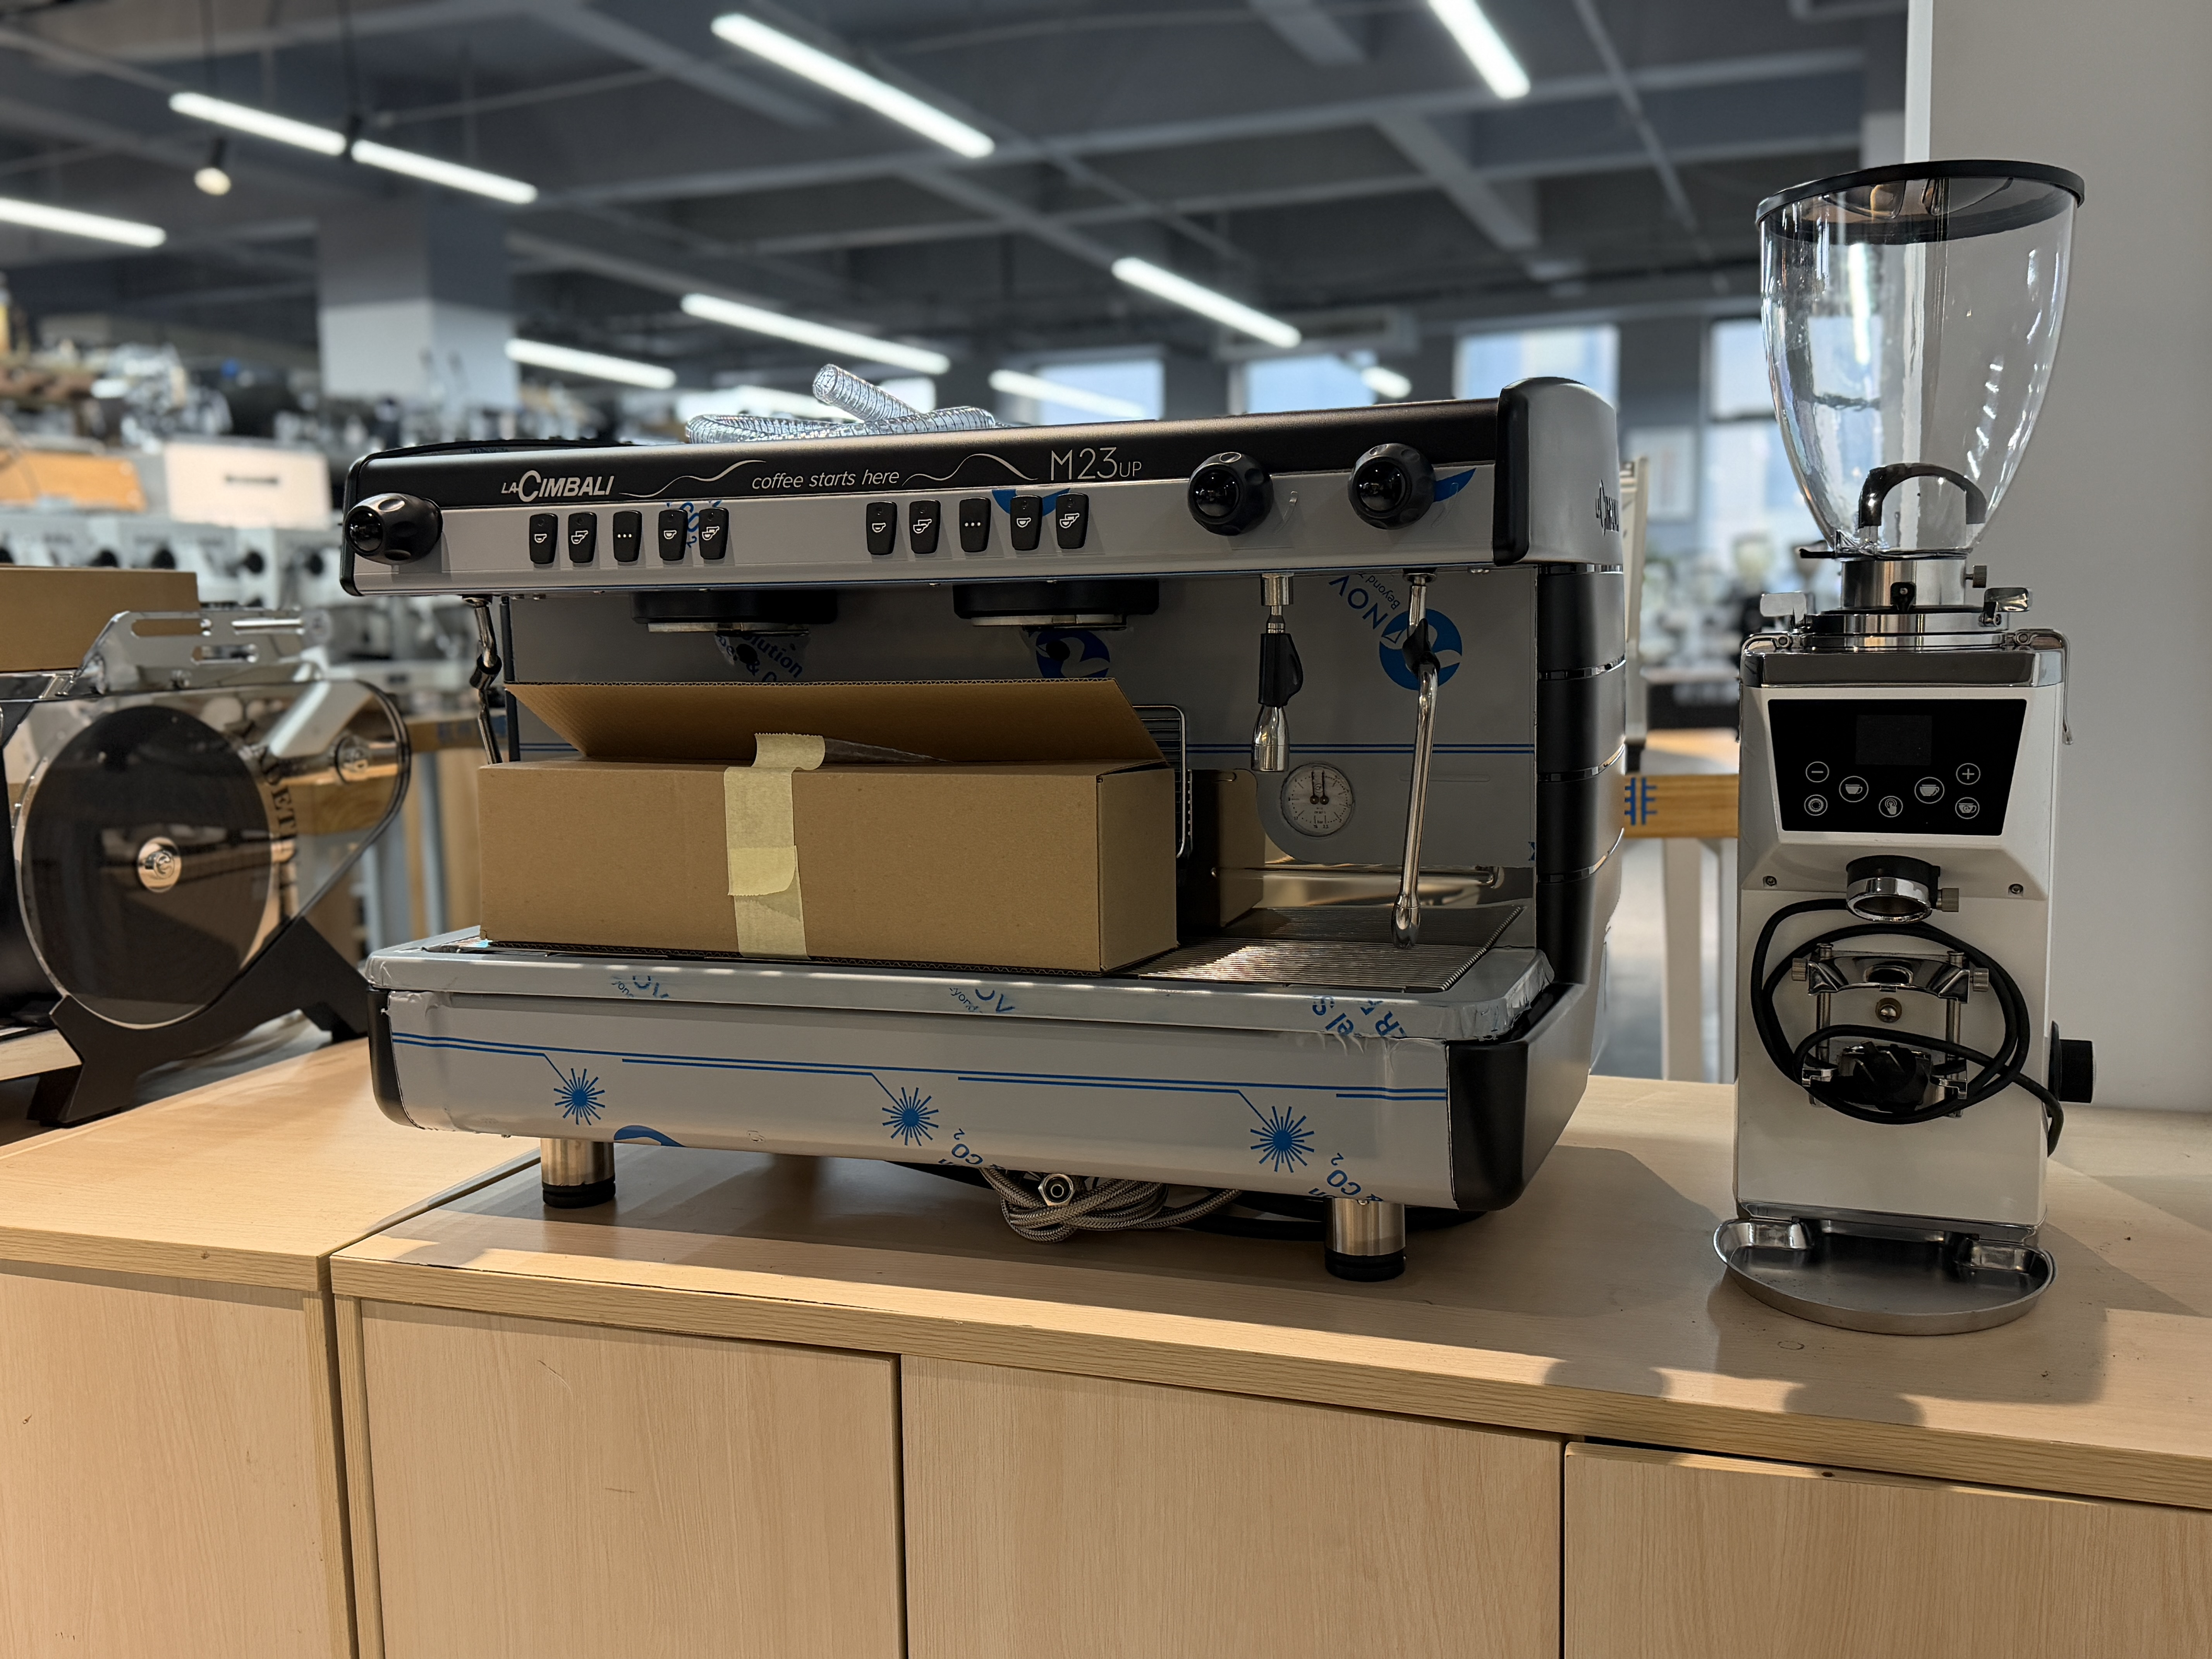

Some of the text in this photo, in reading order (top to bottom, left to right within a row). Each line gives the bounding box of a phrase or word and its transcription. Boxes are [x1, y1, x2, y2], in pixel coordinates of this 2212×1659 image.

[501, 470, 615, 503] LA CIMBALI
[752, 469, 899, 489] coffee starts here
